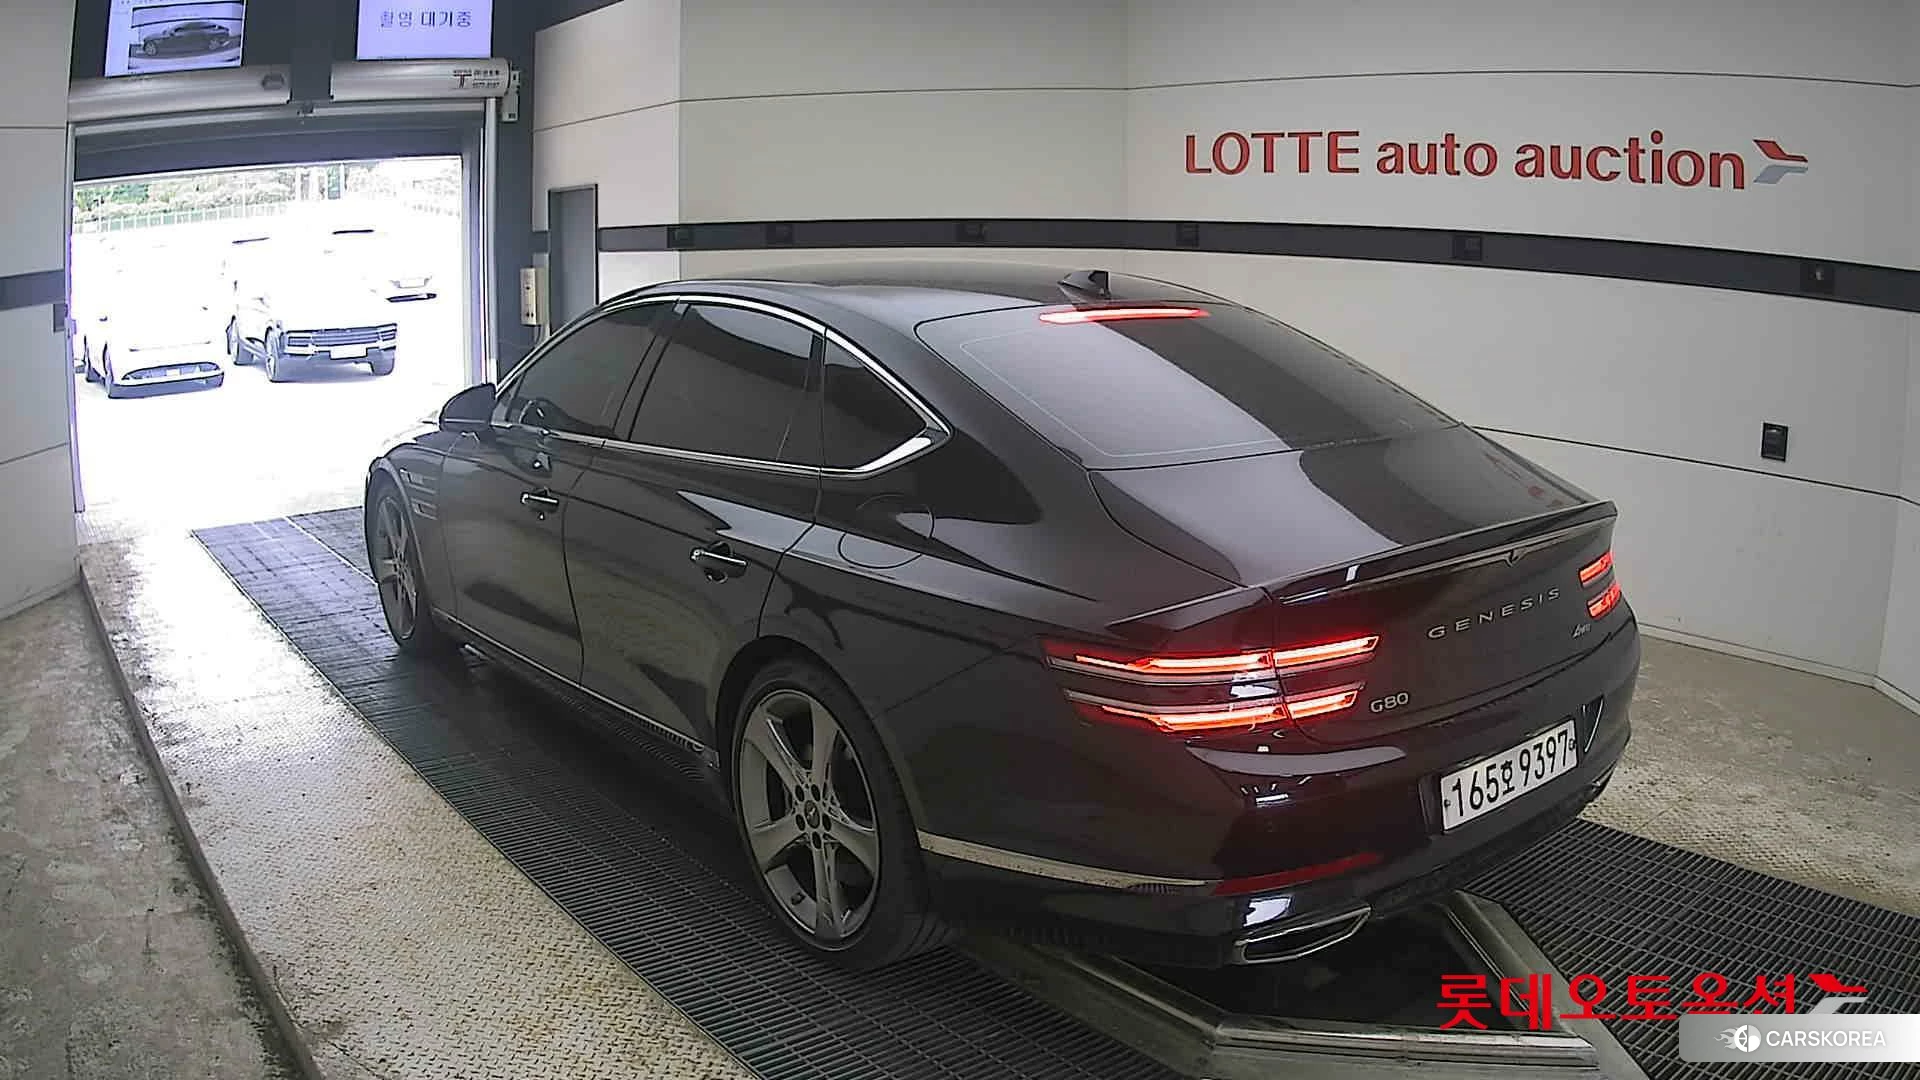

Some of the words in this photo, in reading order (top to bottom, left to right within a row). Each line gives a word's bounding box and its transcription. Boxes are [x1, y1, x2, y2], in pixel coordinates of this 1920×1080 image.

[420, 10, 472, 28] 대기중
[1185, 130, 1360, 176] LOTTE
[1376, 132, 1498, 178] auto
[1514, 130, 1745, 190] auction
[1427, 587, 1561, 639] GENESIS
[1370, 691, 1410, 714] G80
